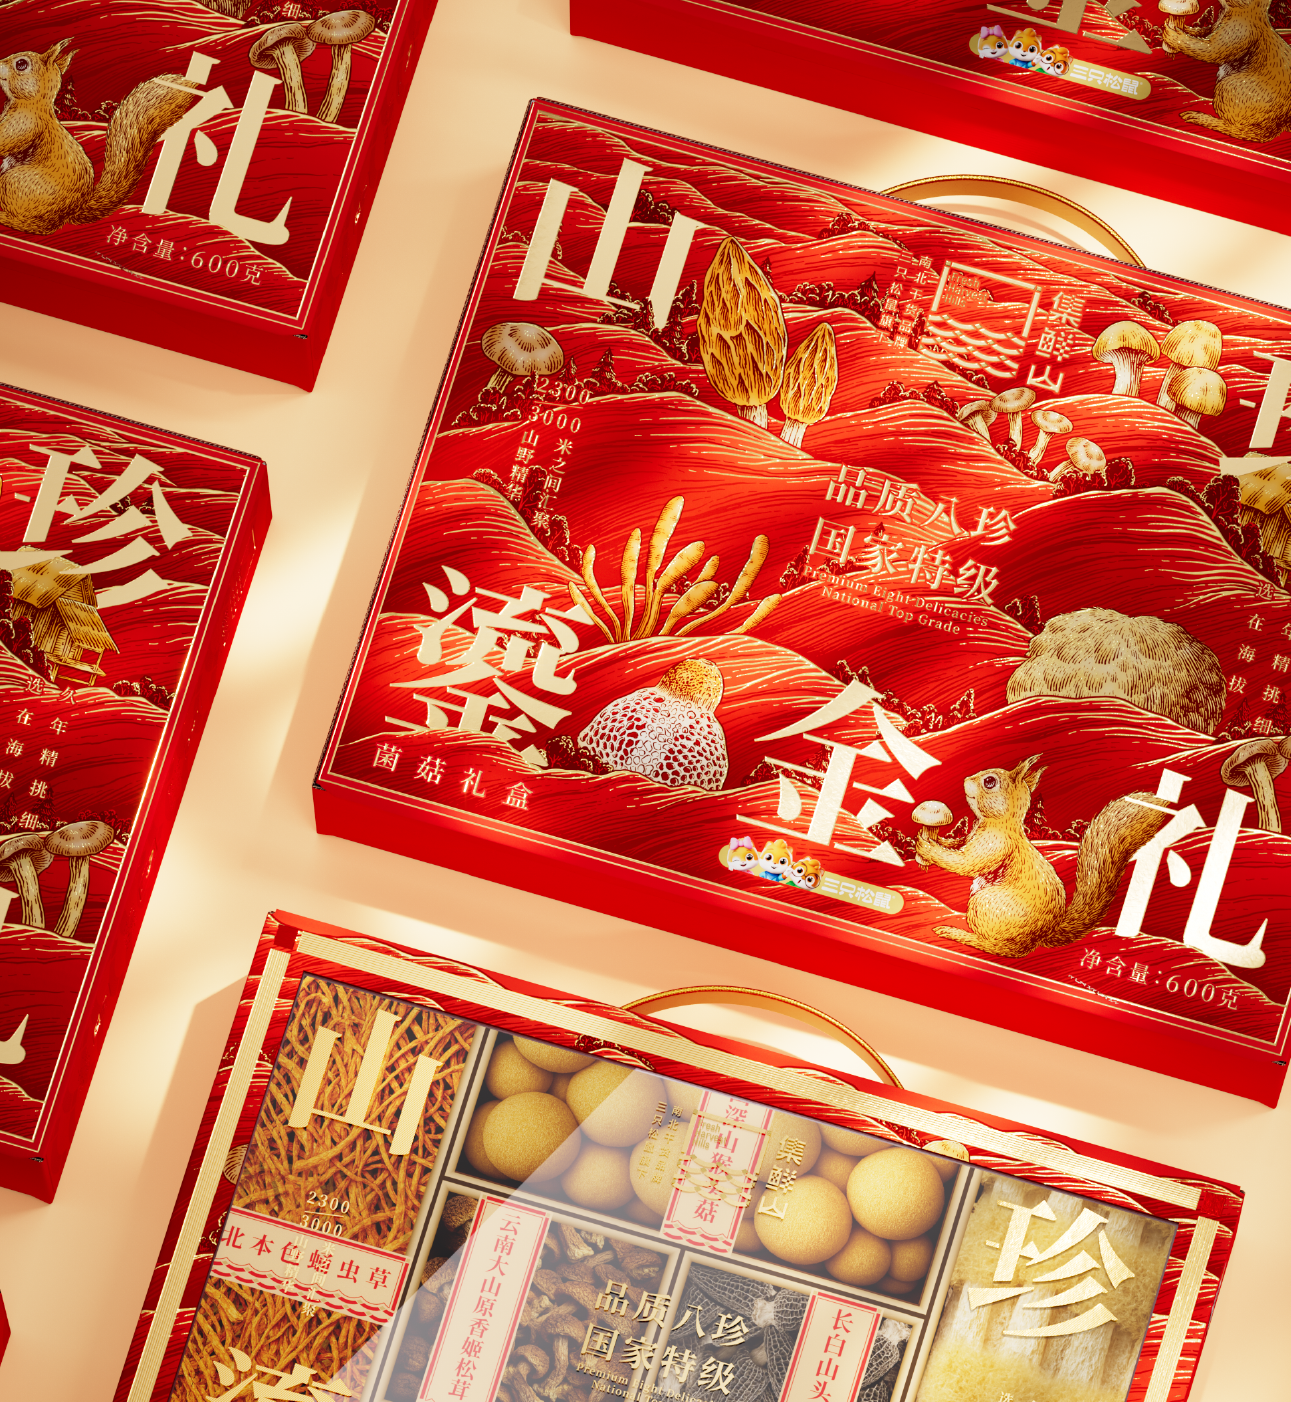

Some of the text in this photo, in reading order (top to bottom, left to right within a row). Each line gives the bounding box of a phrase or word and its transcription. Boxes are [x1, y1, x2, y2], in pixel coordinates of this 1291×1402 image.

[1069, 63, 1139, 96] 三只松鼠
[141, 51, 293, 245] 礼
[513, 157, 703, 329] 山
[944, 293, 967, 309] Hills
[947, 283, 989, 302] Harvest
[950, 271, 980, 289] Fresh
[528, 405, 581, 433] 3000
[536, 377, 591, 405] 2300
[506, 429, 540, 502] 山野精华
[824, 463, 1018, 546] 品质八珍
[808, 516, 1000, 606] 国家特级
[802, 565, 990, 628] Premium Eight Delicacies
[821, 586, 961, 635] National Top Grade
[371, 741, 535, 813] 菌菇礼盒
[735, 676, 942, 866] 金
[821, 877, 892, 910] 三只松鼠
[1114, 767, 1268, 969] 礼
[287, 1008, 445, 1156] 山
[300, 1215, 343, 1238] 3000
[306, 1191, 350, 1214] 2300
[967, 1199, 1136, 1338] 珍
[448, 1212, 522, 1401] 云南大山原香姬松茸
[594, 1279, 750, 1347] 品质八珍
[576, 1362, 629, 1386] Premium
[632, 1378, 665, 1396] Eight
[580, 1322, 735, 1396] 国家特级
[591, 1379, 641, 1402] National
